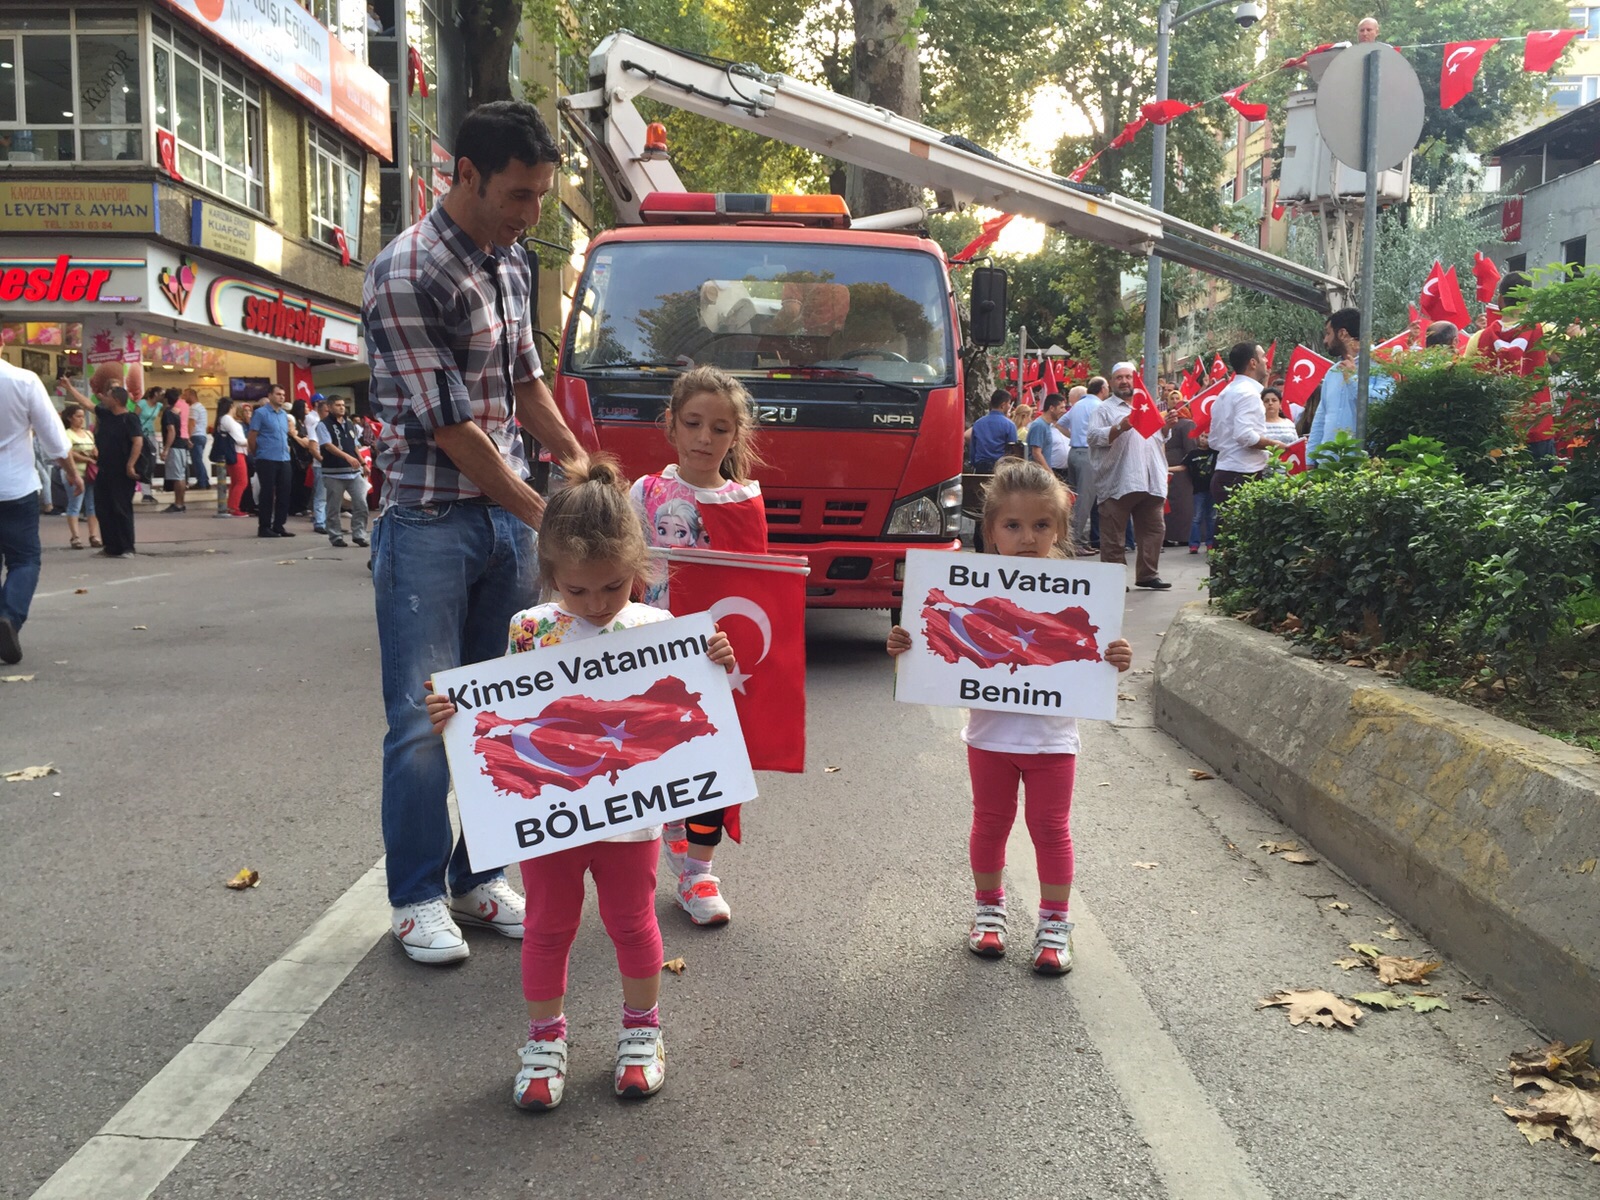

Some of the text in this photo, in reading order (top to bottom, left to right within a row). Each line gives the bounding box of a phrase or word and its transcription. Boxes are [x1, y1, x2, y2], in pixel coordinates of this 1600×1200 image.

[284, 6, 322, 61] Eğitim
[54, 187, 86, 200] ERKEK
[4, 203, 149, 217] LEVENT & AYHAN
[69, 220, 85, 230] 331
[0, 254, 111, 302] esler
[244, 288, 326, 347] serbesler
[597, 407, 639, 416] TURBO
[752, 406, 798, 423] ZU
[873, 413, 915, 425] NPR
[949, 565, 1091, 595] Bu Vatan
[447, 634, 708, 713] Kimse Vatanımı
[959, 678, 1062, 708] Benim
[514, 770, 723, 848] BÖLEMEZ
